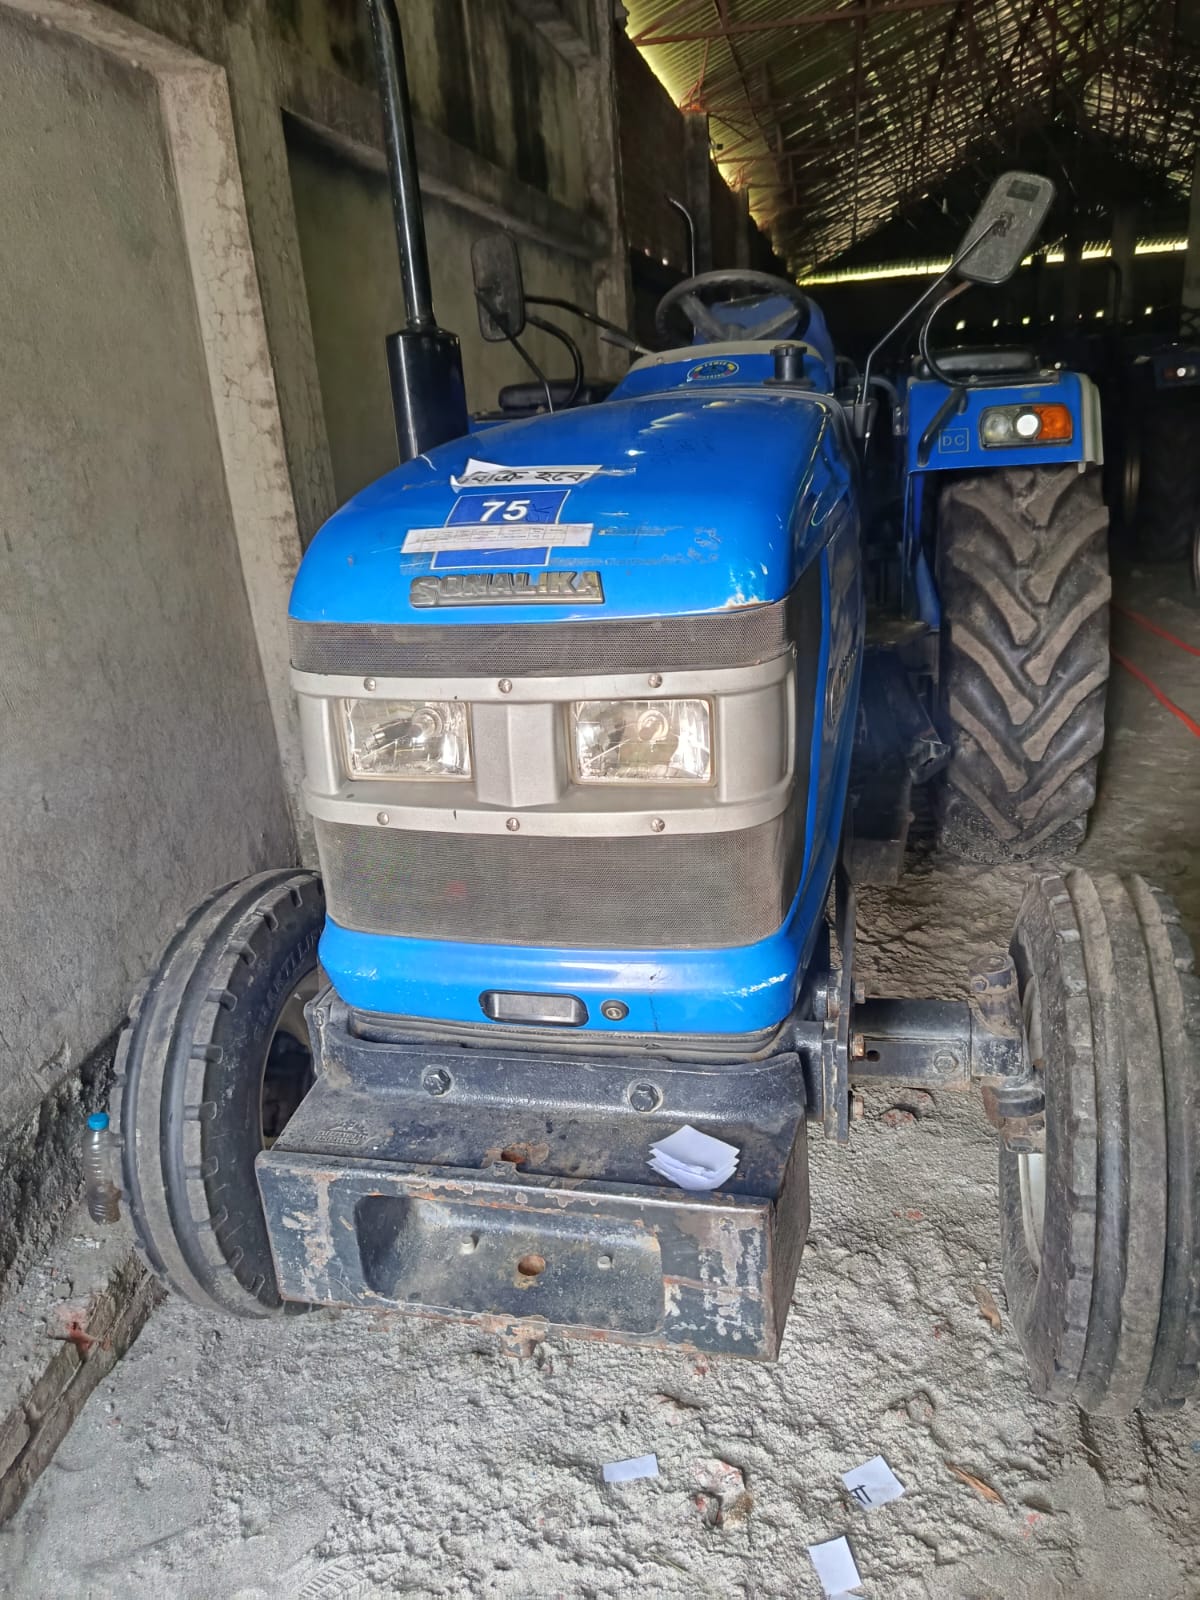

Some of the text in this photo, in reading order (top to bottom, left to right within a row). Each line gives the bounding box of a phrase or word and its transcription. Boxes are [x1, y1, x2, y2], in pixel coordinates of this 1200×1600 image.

[535, 470, 590, 483] হবে
[480, 500, 530, 522] 75
[411, 572, 601, 605] SONALIKA
